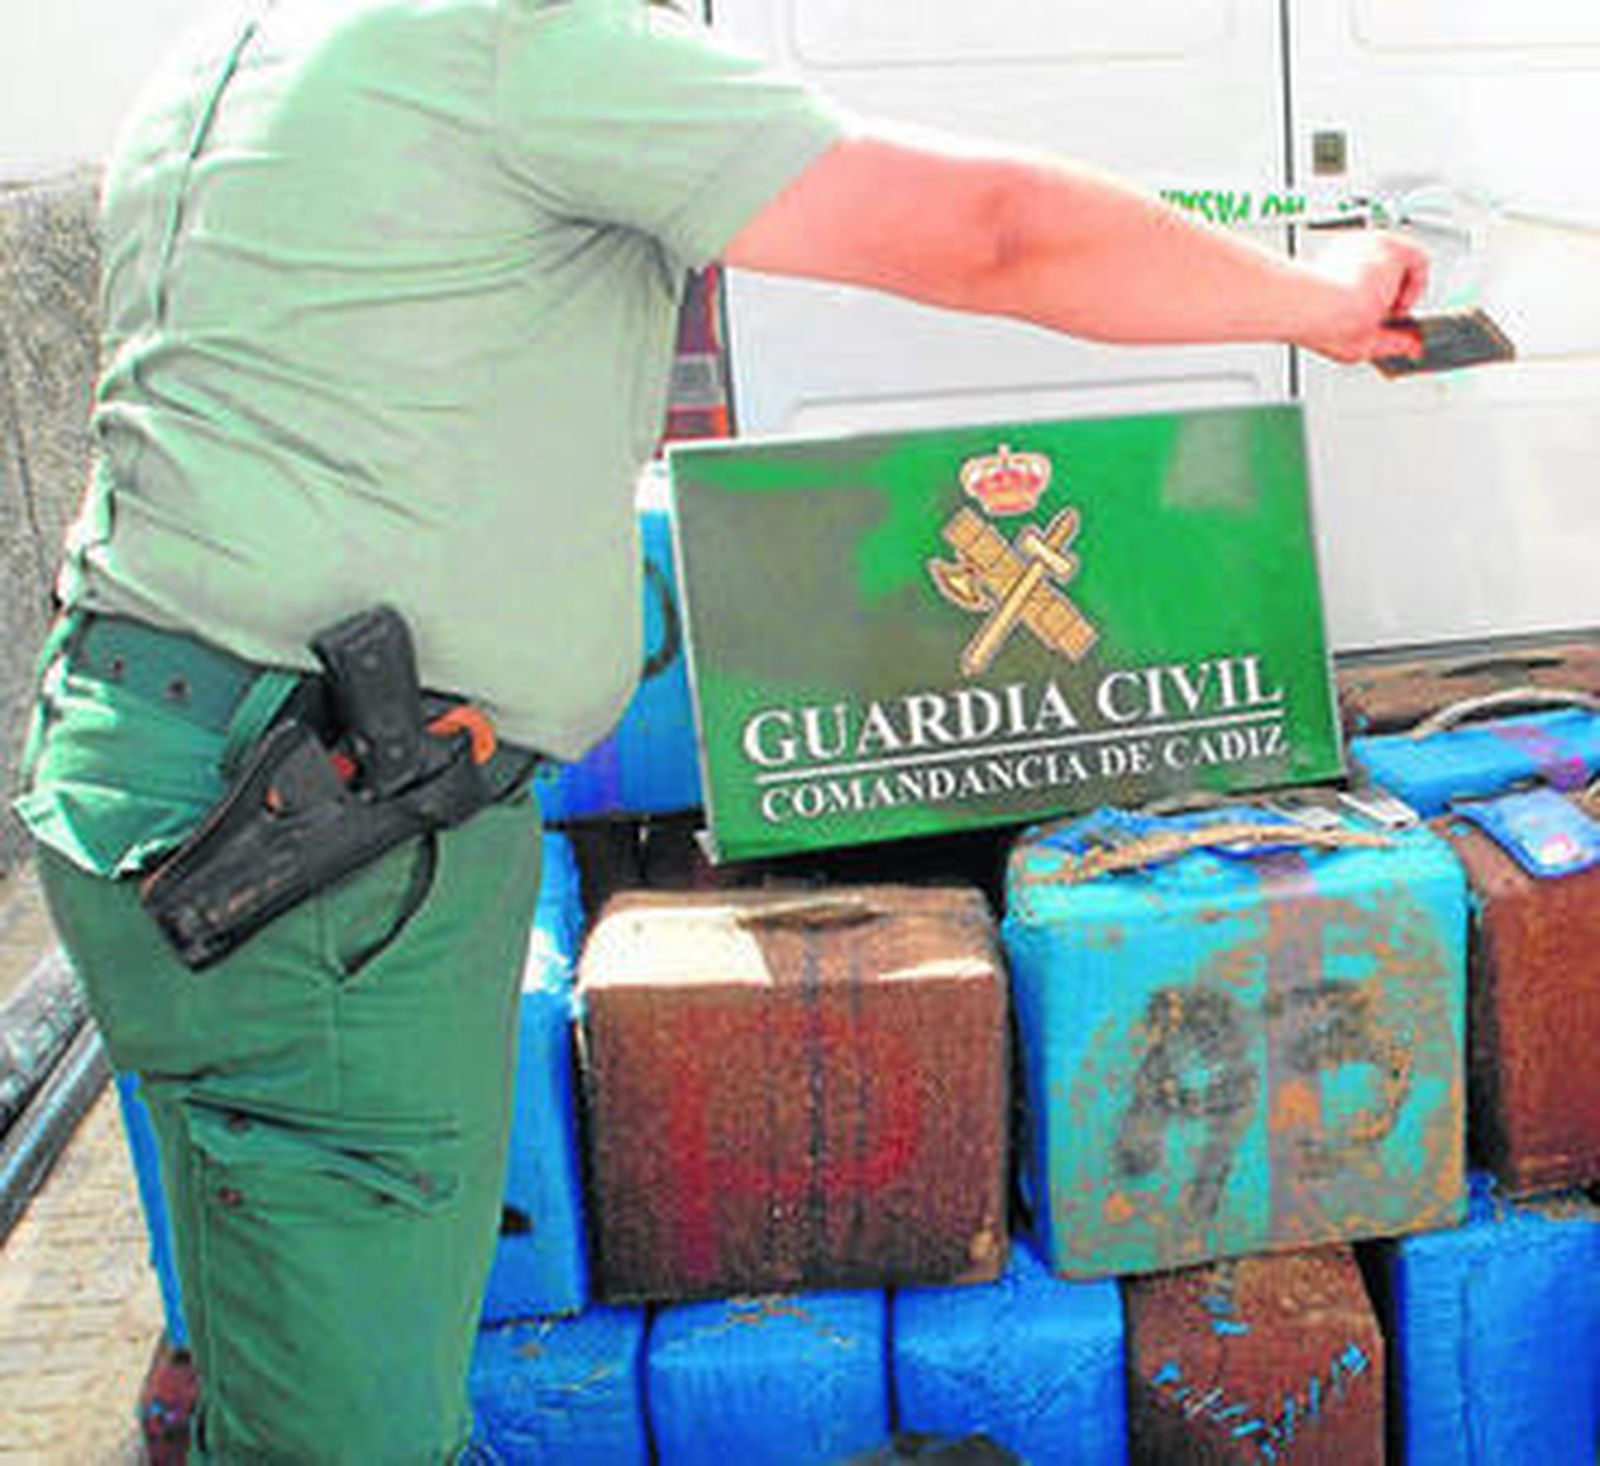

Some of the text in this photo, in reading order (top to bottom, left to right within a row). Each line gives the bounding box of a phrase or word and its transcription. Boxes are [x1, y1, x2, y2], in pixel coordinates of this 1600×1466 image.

[742, 655, 1284, 767] GUARDIA CIVIL
[760, 752, 1089, 823] COMANDANCIA
[1100, 742, 1153, 777] DE
